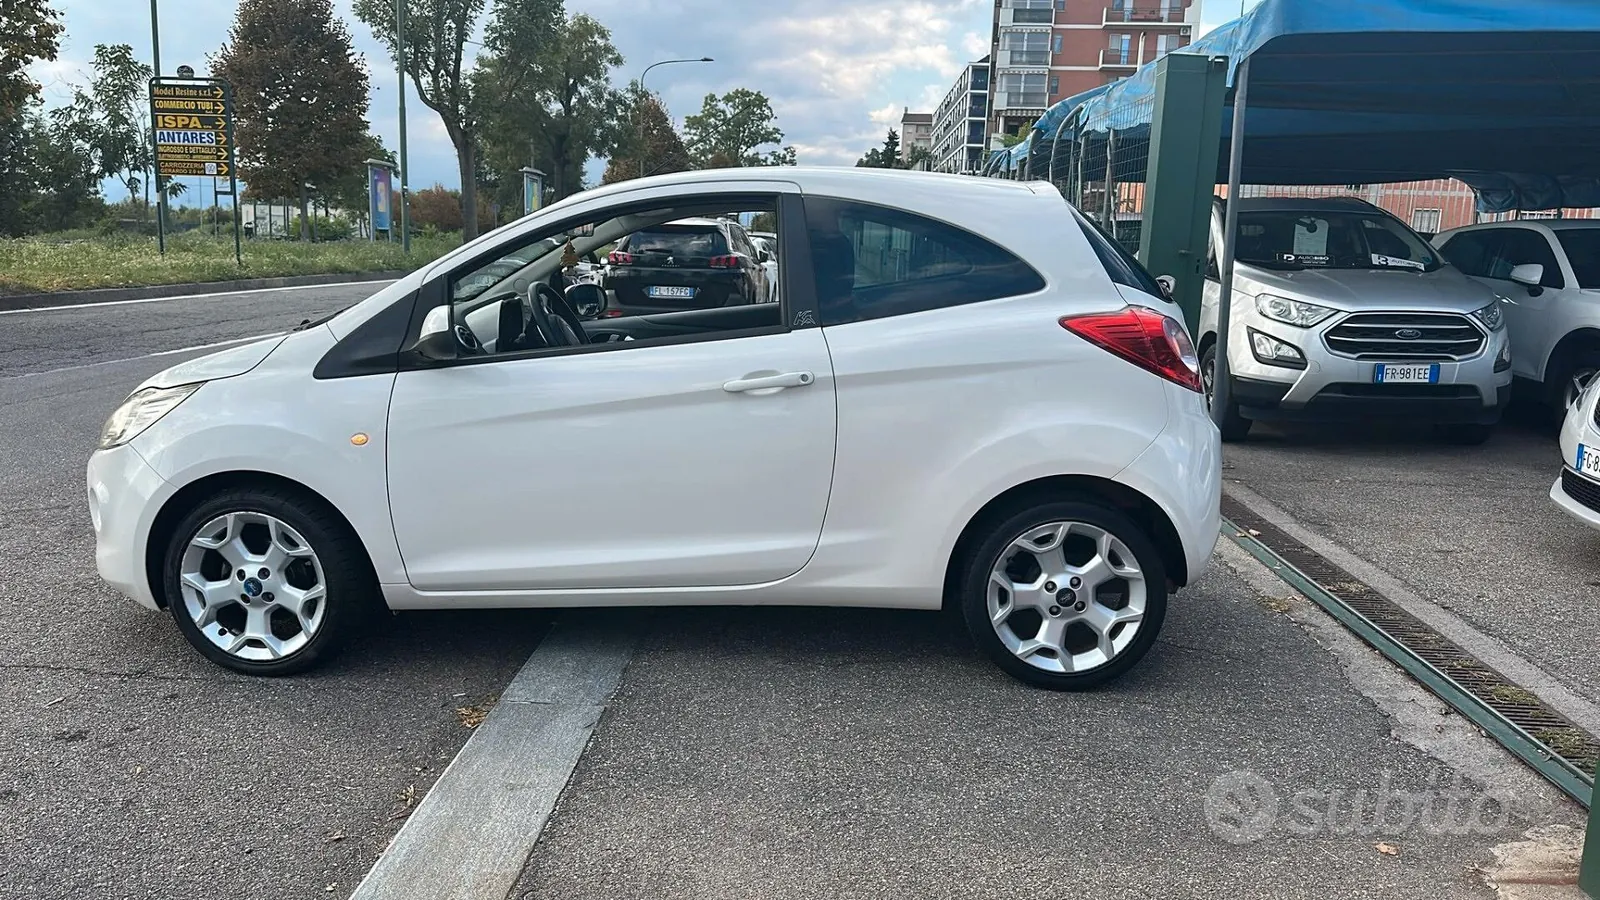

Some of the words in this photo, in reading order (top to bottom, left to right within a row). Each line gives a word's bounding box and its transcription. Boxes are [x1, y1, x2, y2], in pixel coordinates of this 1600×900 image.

[153, 86, 174, 96] Model
[175, 87, 198, 96] Resine
[154, 100, 196, 109] COMMERCIO
[196, 101, 213, 110] TUBI
[157, 115, 203, 129] ISPA
[158, 131, 215, 144] ANTARES
[158, 145, 184, 154] INGROSSO
[184, 146, 189, 154] E
[189, 146, 217, 155] DETTAGLIO
